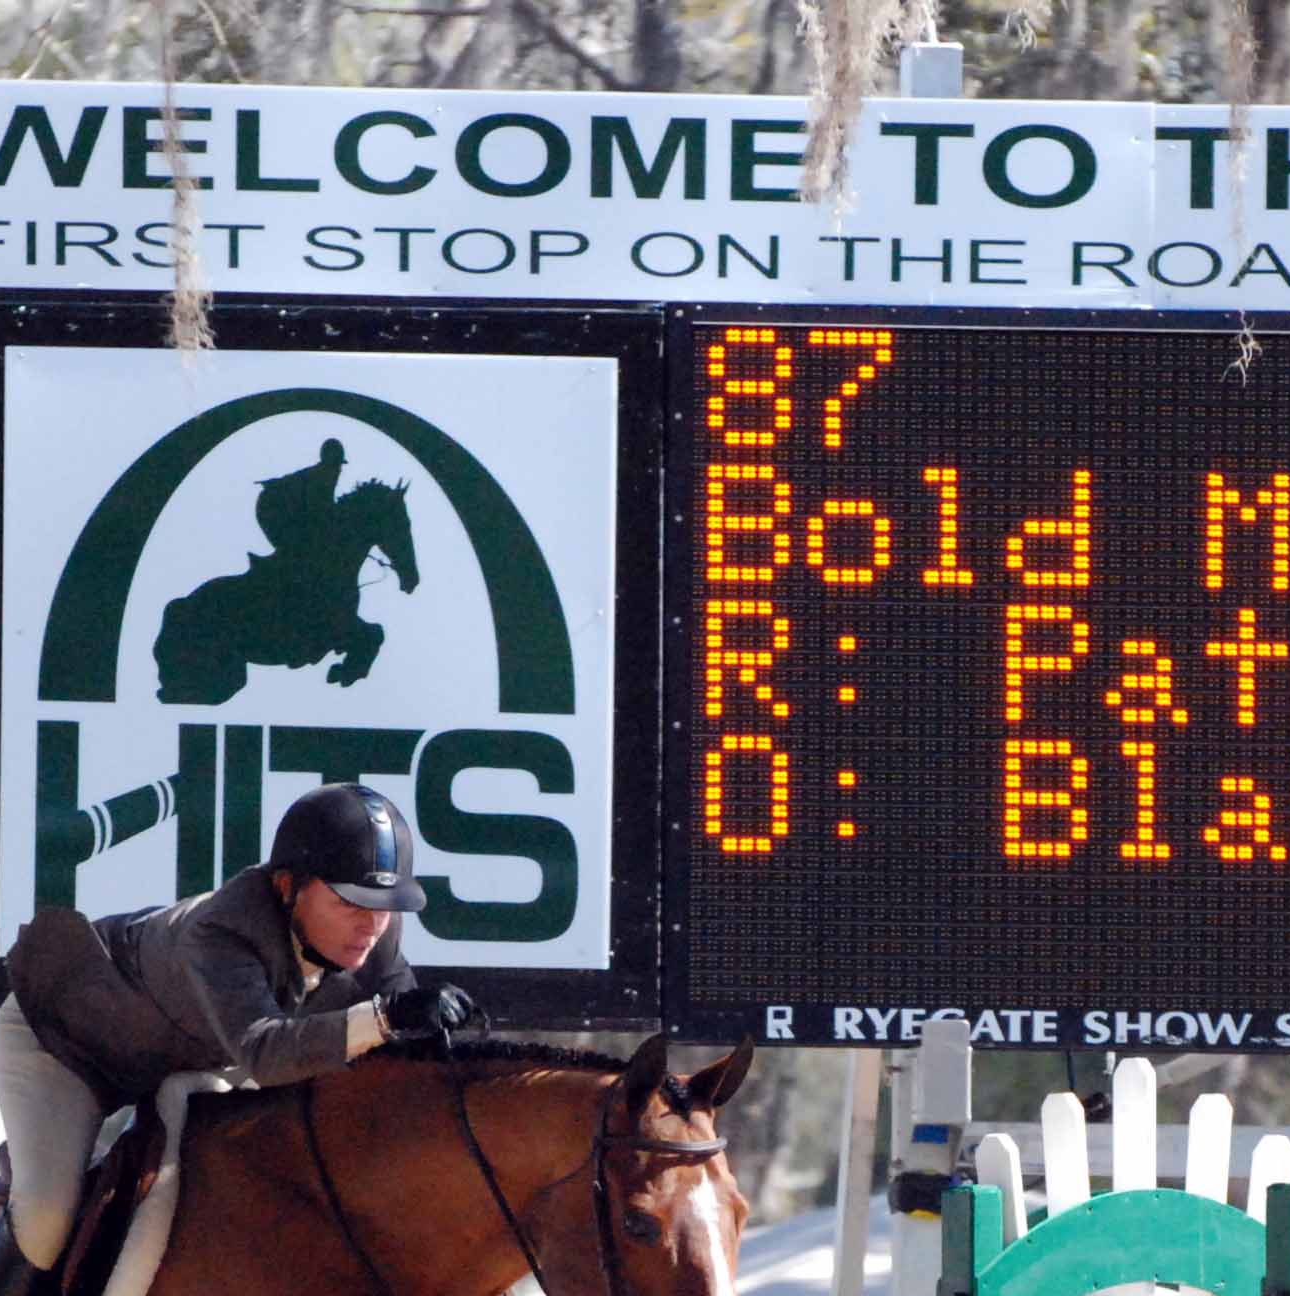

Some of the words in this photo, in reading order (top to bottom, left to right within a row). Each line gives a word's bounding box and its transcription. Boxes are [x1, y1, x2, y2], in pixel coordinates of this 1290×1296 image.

[881, 123, 1096, 208] TO
[305, 227, 589, 273] STOP
[632, 233, 778, 278] ON
[819, 237, 1026, 284] THE
[708, 329, 891, 447] 87
[707, 464, 1090, 586] Bold
[706, 600, 855, 716] R:
[705, 735, 854, 851] O:
[1085, 1011, 1252, 1044] SHOW
